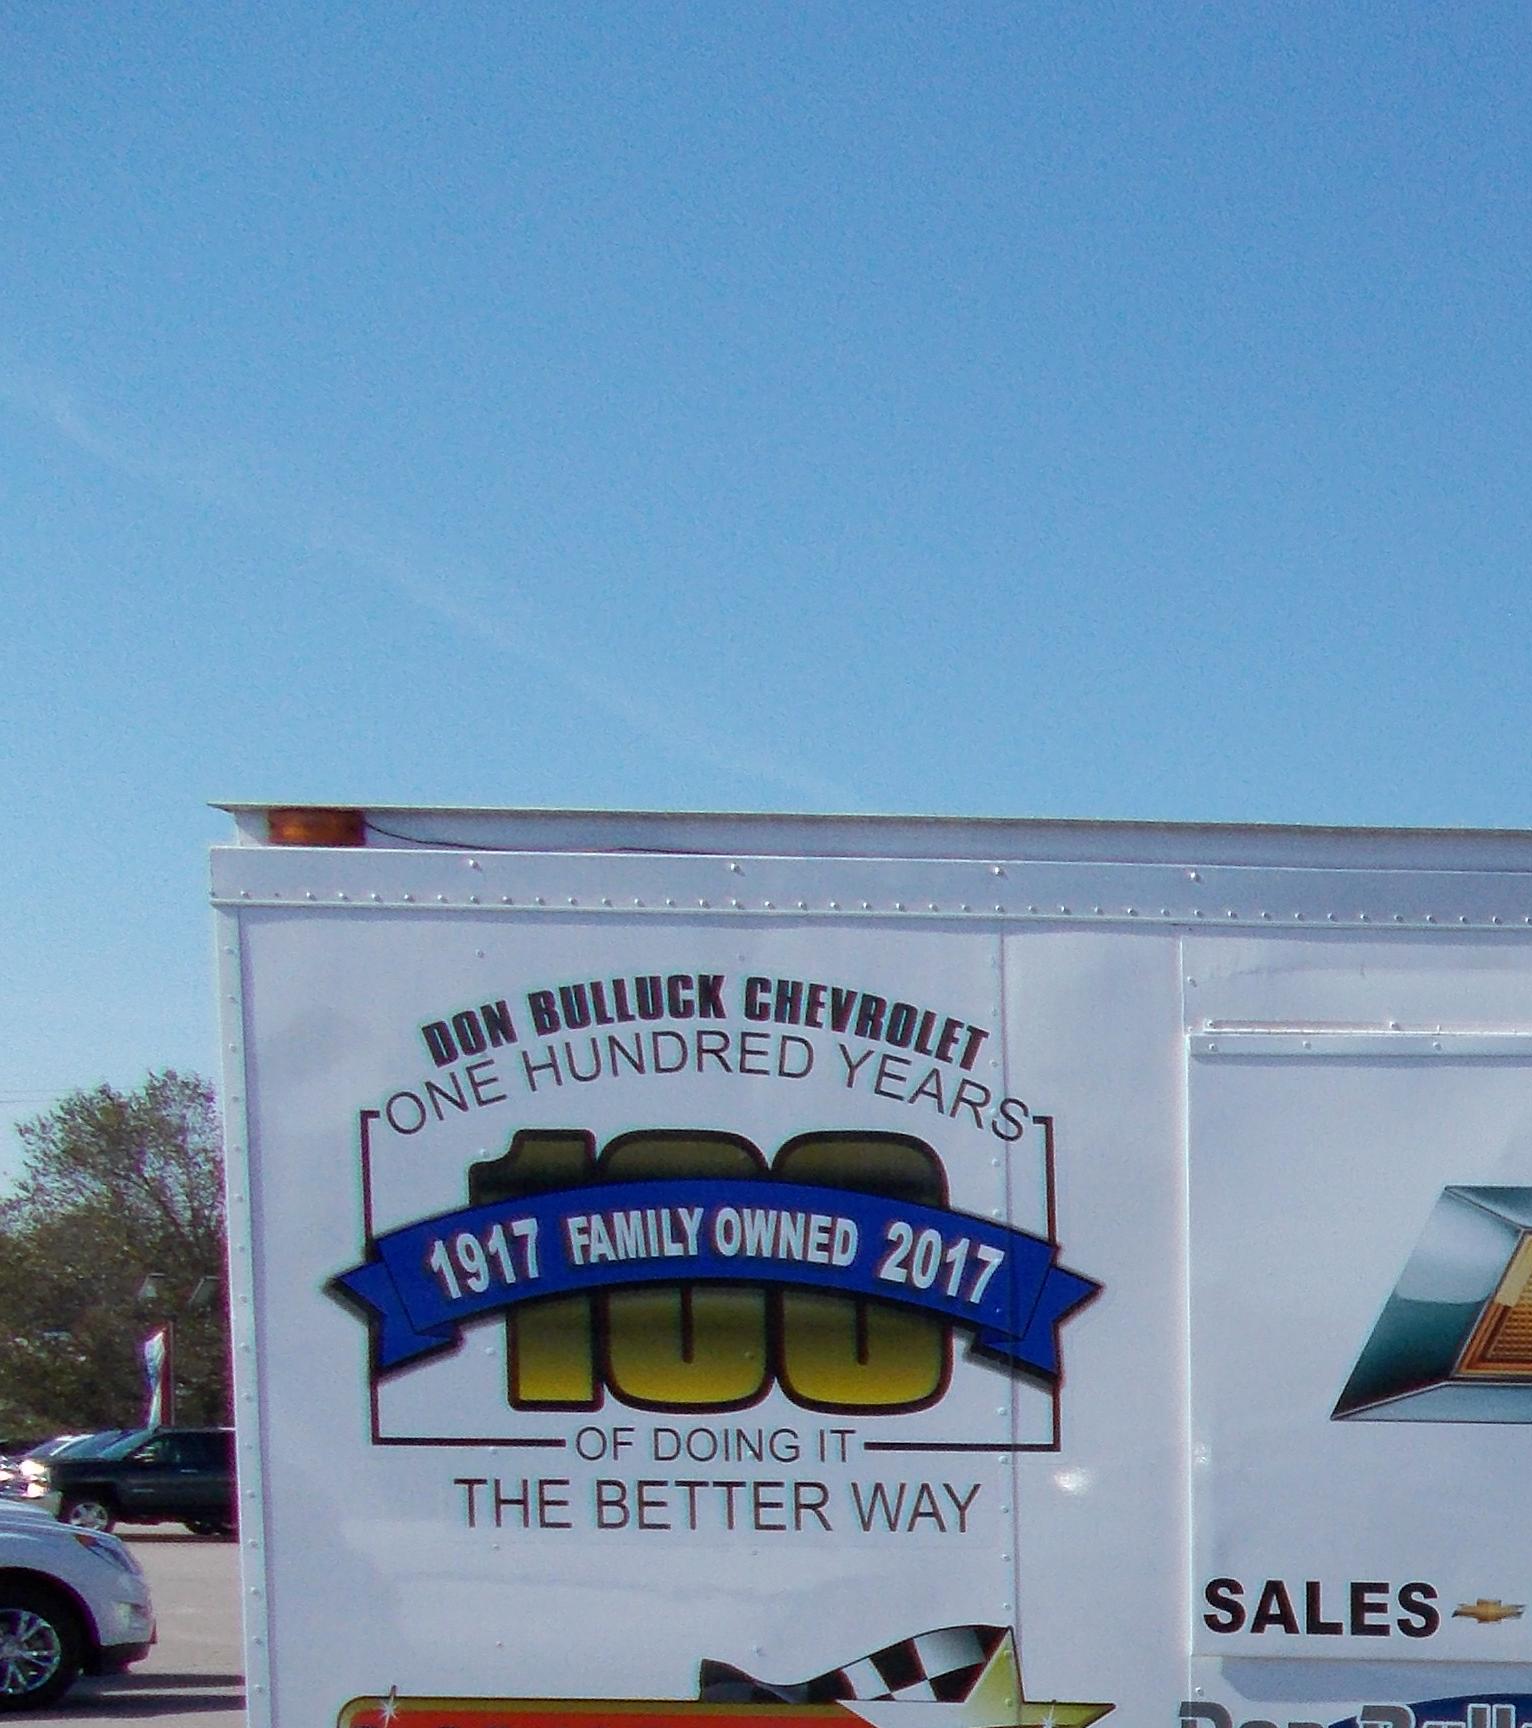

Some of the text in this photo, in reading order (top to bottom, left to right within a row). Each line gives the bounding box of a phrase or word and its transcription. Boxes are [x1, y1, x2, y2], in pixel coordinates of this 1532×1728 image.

[421, 973, 989, 1071] DON BULLUCK CHEVROLET
[385, 1030, 1030, 1144] ONE HUNDRED YEARS
[429, 1206, 1005, 1306] 1917 FAMILY OWNED 2017
[576, 1425, 856, 1464] OF DOING IT
[455, 1477, 982, 1534] THE BETTER WAY
[1202, 1577, 1441, 1638] SALES
